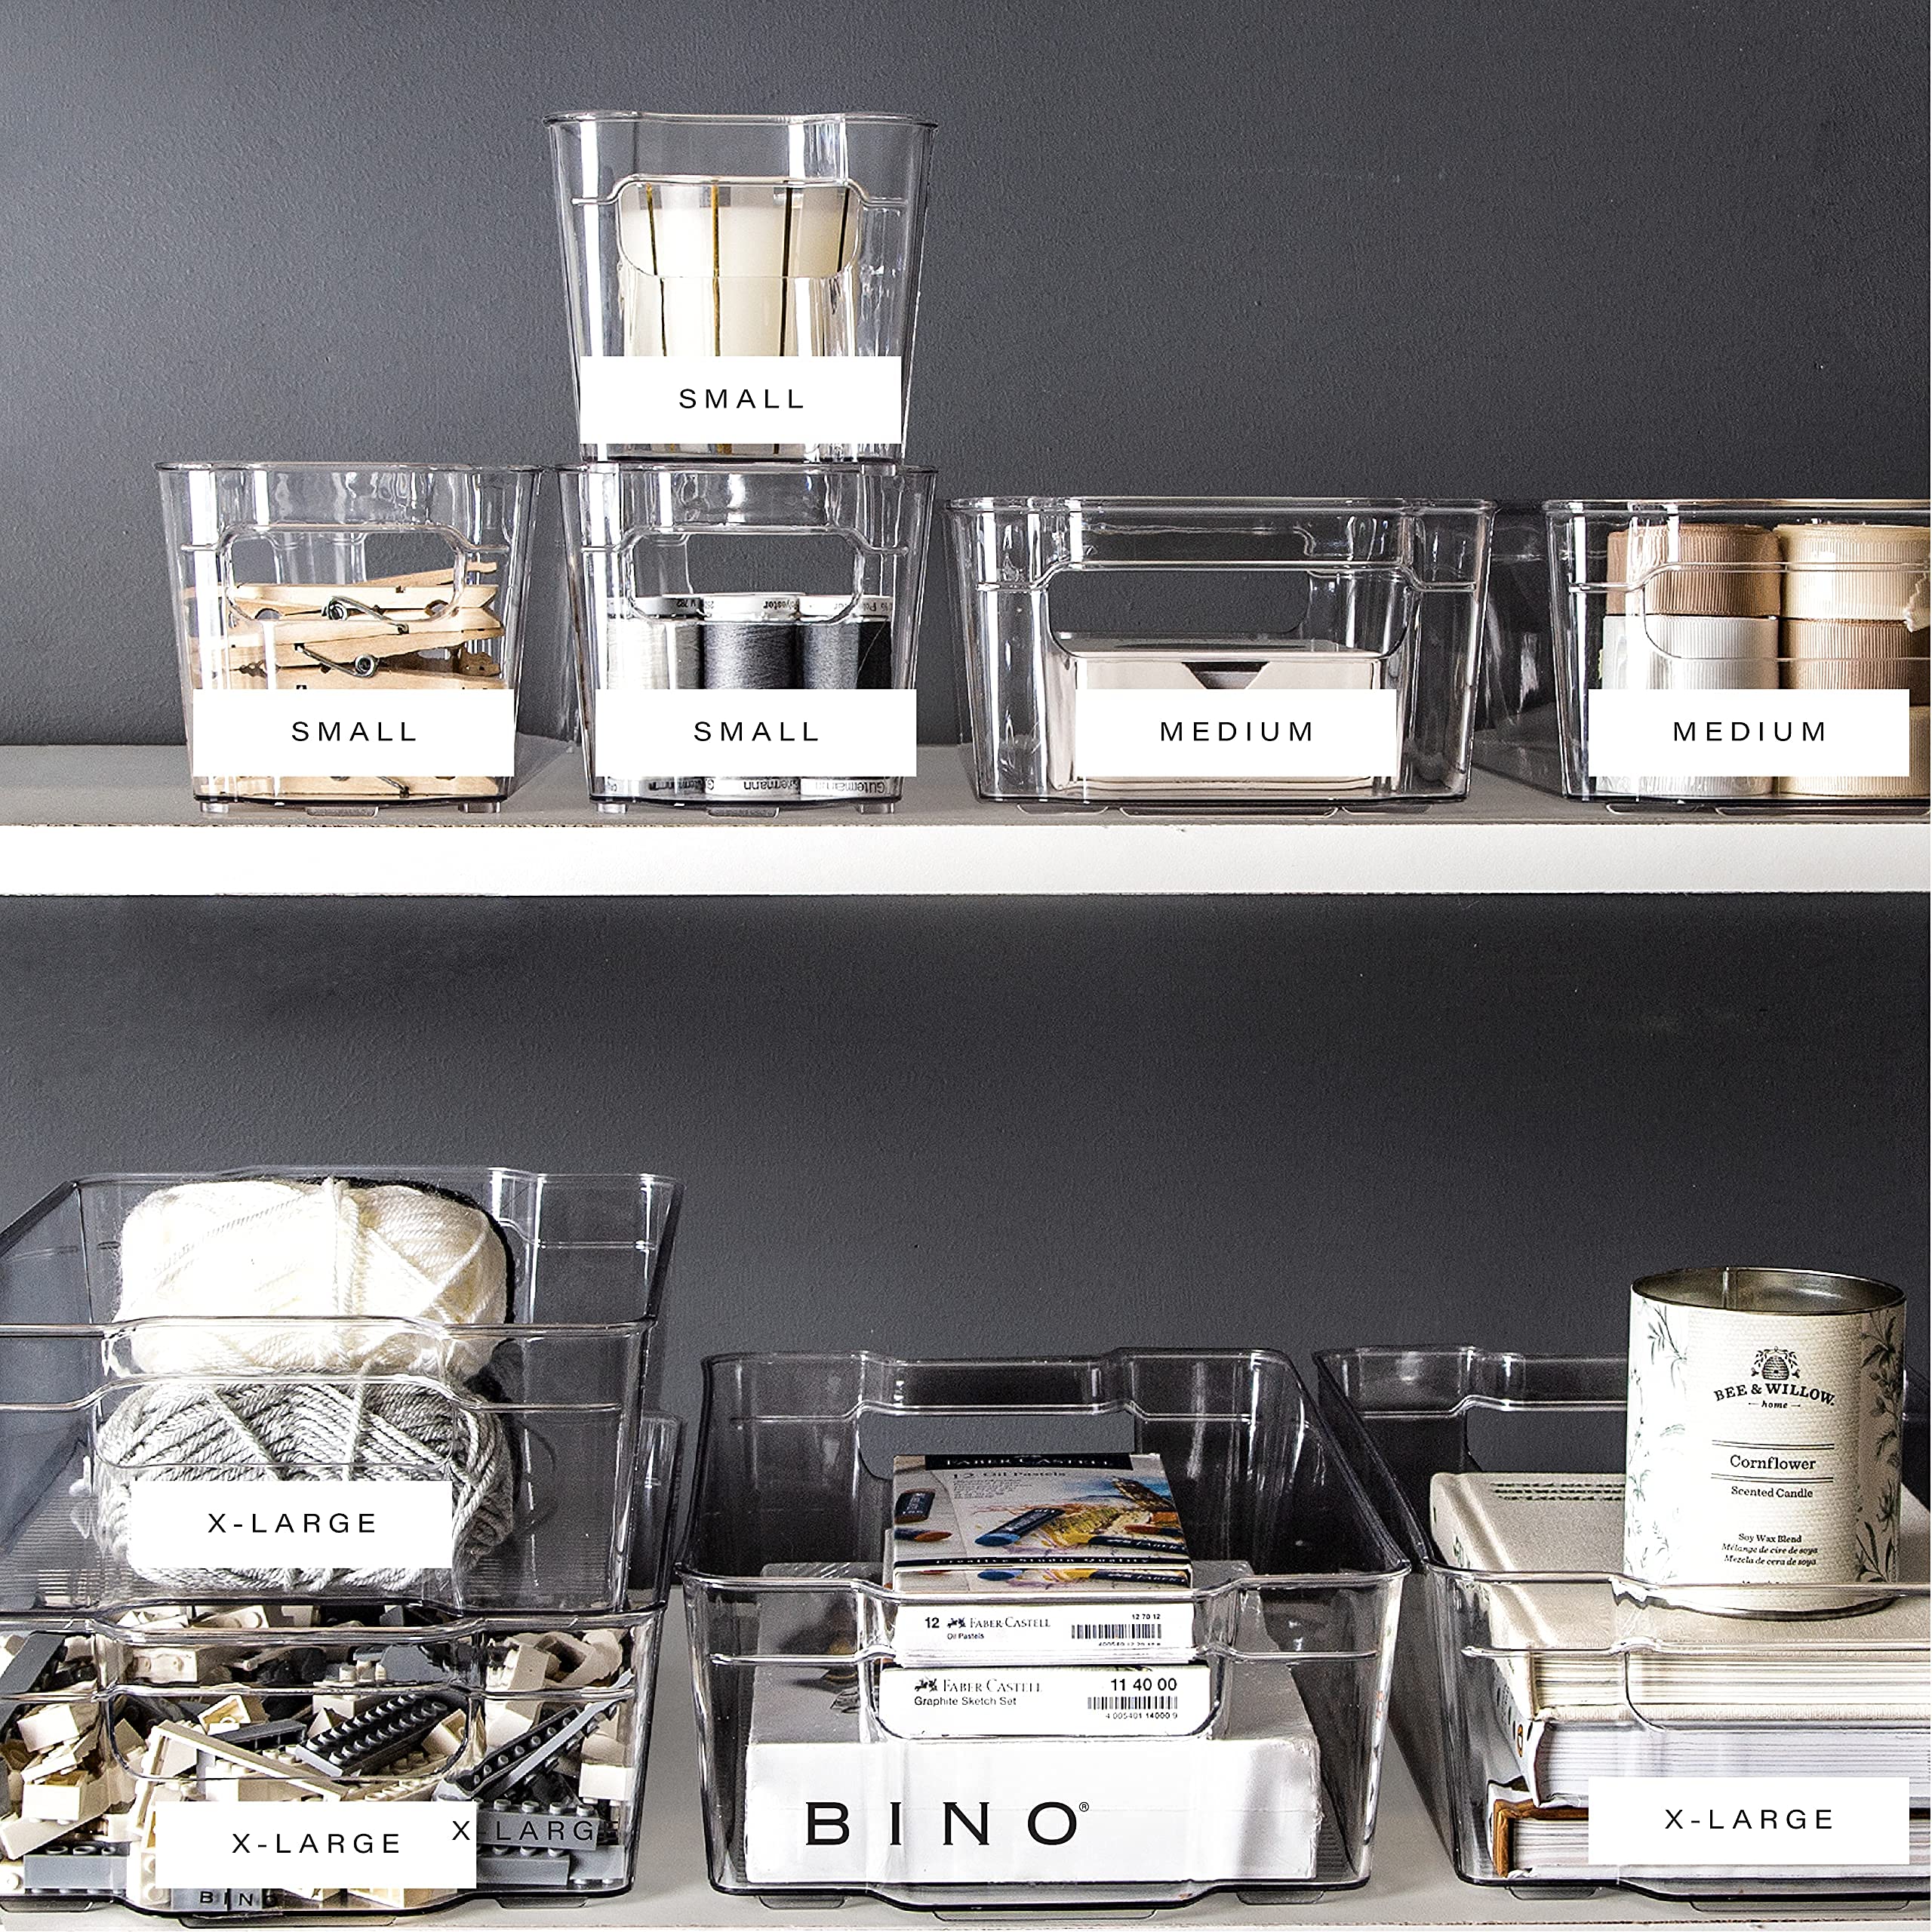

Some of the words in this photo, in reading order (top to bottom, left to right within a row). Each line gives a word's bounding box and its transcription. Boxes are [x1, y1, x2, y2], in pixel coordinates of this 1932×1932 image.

[1713, 1384, 1748, 1401] BEE
[1750, 1383, 1762, 1395] &
[1761, 1401, 1788, 1409] home
[1730, 1454, 1817, 1469] Cornflower
[1730, 1486, 1774, 1497] Scented
[1775, 1488, 1814, 1498] Candle
[1738, 1534, 1755, 1543] Soy
[1756, 1534, 1776, 1543] Wax
[1777, 1534, 1802, 1543] Blend
[1770, 1546, 1787, 1555] cire
[1788, 1546, 1798, 1555] de
[1786, 1558, 1796, 1566] de
[925, 1617, 940, 1629] 12
[1110, 1678, 1126, 1691] 11
[1133, 1678, 1152, 1691] 40
[1157, 1677, 1177, 1691] 00
[914, 1696, 958, 1707] Graphite
[961, 1697, 997, 1706] Sketch
[999, 1697, 1017, 1706] Set
